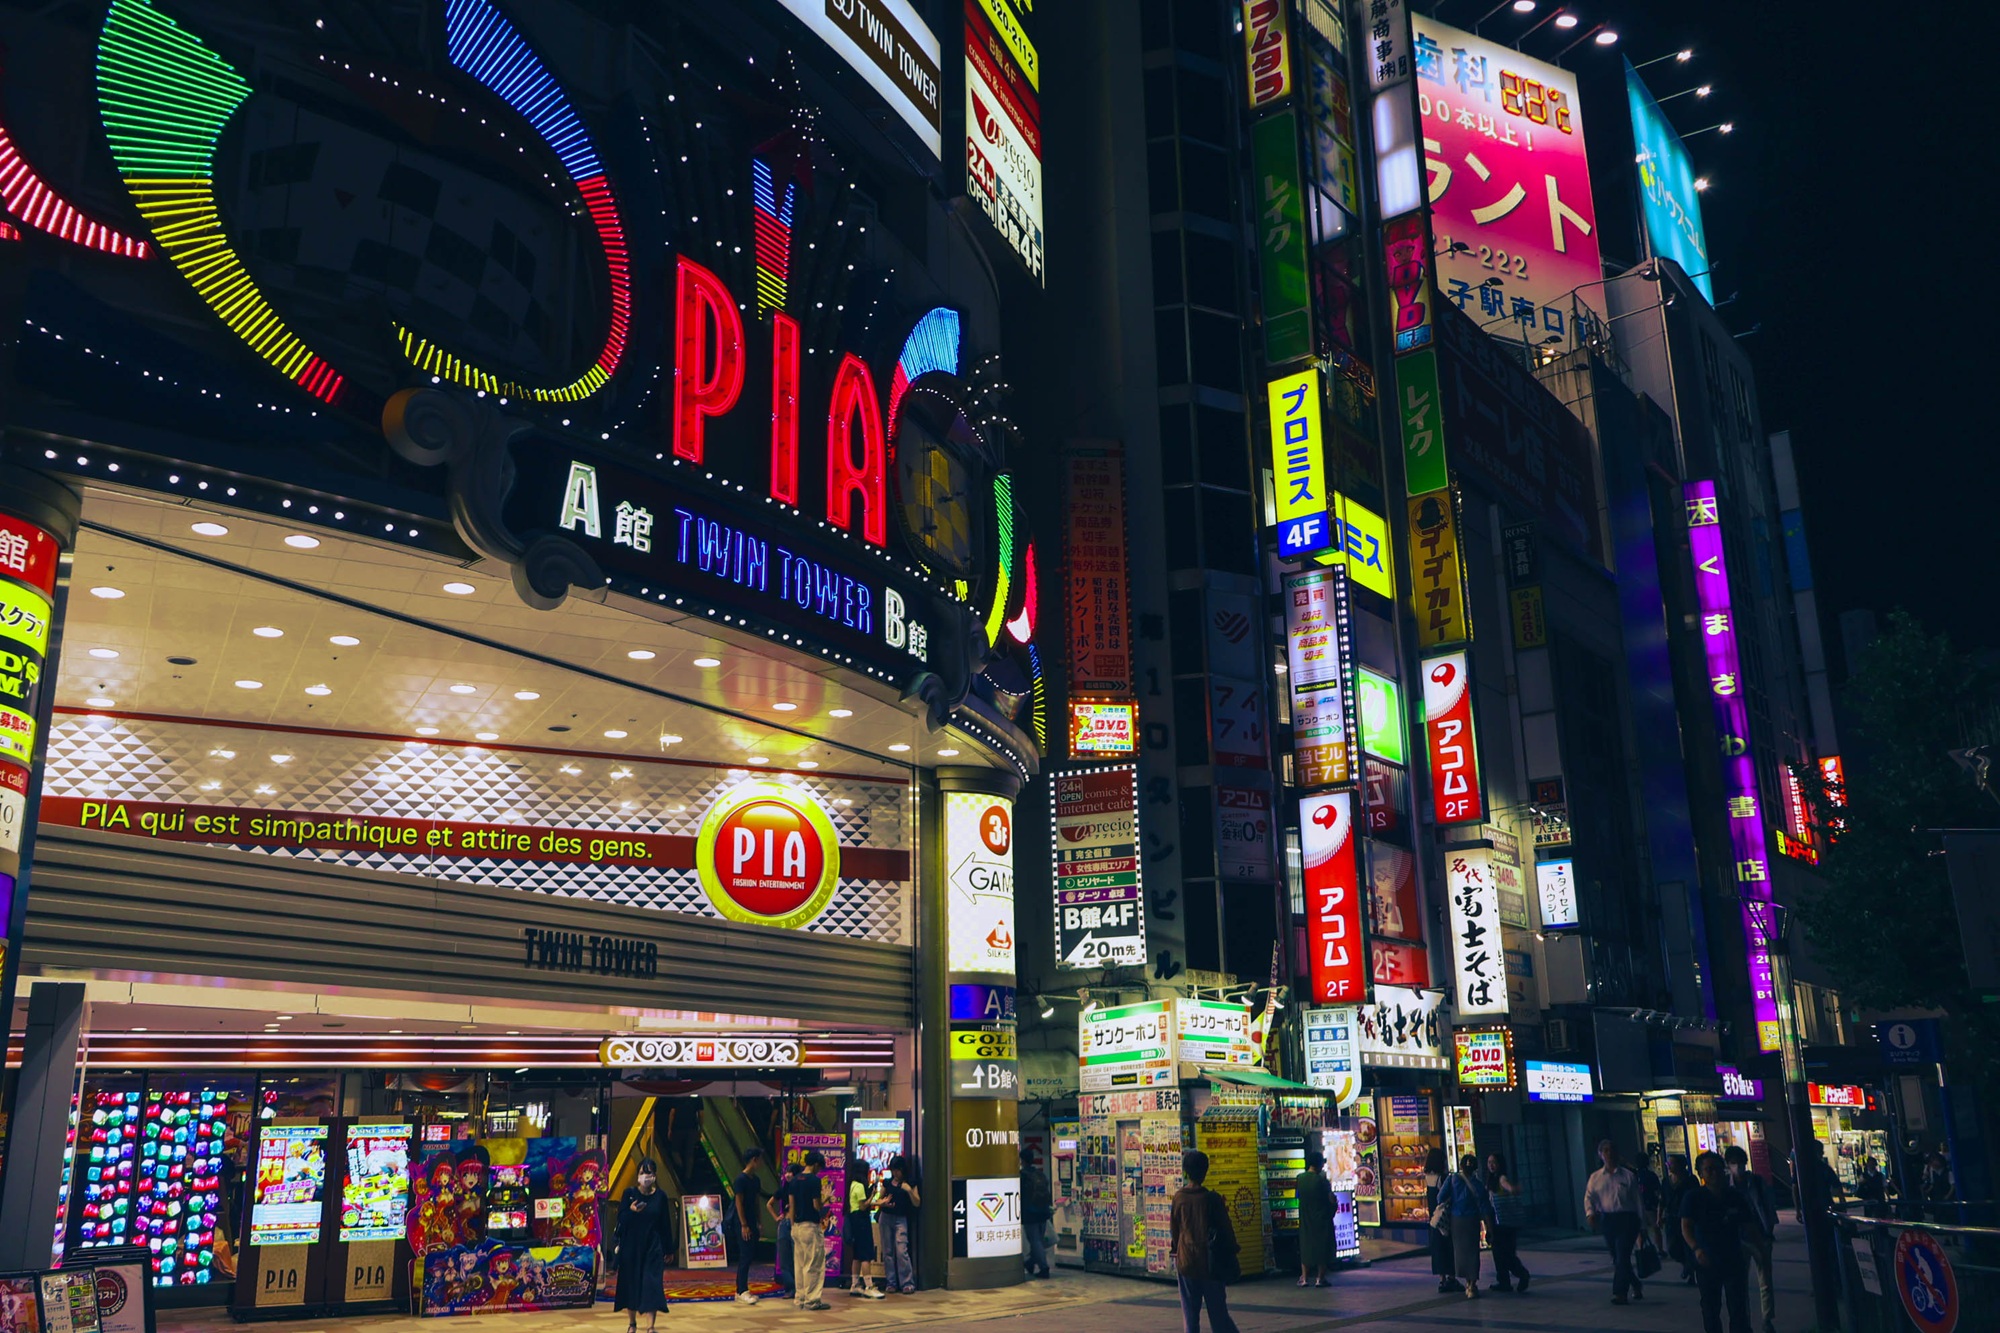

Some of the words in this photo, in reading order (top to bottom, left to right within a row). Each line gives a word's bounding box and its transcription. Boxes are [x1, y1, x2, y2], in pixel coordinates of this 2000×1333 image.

[858, 0, 893, 60] TWIN
[898, 43, 937, 110] TOWER
[968, 142, 995, 197] 24H
[968, 174, 995, 222] OPEN
[1263, 175, 1292, 253] レイク
[1433, 234, 1528, 281] 1-222
[673, 253, 887, 549] PIA
[1407, 385, 1434, 457] レイク
[1281, 383, 1315, 505] プロミス
[1286, 518, 1320, 549] 4F
[674, 505, 769, 594] TWIN
[776, 547, 873, 635] TOWER
[1292, 622, 1332, 637] チケット
[1094, 719, 1127, 730] DVD
[1298, 713, 1340, 726] サンクーポン
[1299, 746, 1343, 765] 当ビル
[1437, 719, 1468, 795] アコム
[1060, 781, 1081, 793] 24H
[1060, 792, 1081, 802] OPEN
[1085, 787, 1118, 799] comics
[1120, 785, 1129, 796] &
[1060, 802, 1104, 814] internet
[1222, 789, 1263, 808] アコム
[1445, 799, 1469, 818] 2F
[80, 802, 130, 830] PIA
[140, 809, 186, 837] qui
[194, 812, 240, 836] est
[249, 813, 418, 849] simpathique
[426, 826, 453, 848] et
[461, 826, 531, 852] attire
[539, 831, 583, 858] des
[589, 838, 653, 862] gens.
[988, 814, 1008, 847] 3F
[1075, 817, 1131, 840] aprecio
[733, 827, 806, 878] PIA
[1239, 864, 1254, 877] 2F
[733, 878, 757, 888] FASHION
[759, 879, 805, 890] ENTERTAINMENT
[1076, 876, 1115, 887] ビリヤード
[1319, 886, 1349, 967] アコム
[525, 928, 584, 974] TWIN
[589, 935, 658, 980] TOWER
[1455, 886, 1497, 1006] 富士そば
[1373, 949, 1395, 980] 2F
[1326, 979, 1350, 997] 2F
[1190, 1015, 1241, 1031] サンクーポン
[1310, 1013, 1345, 1024] 新幹線
[1095, 1023, 1156, 1046] サンクーポン
[1311, 1028, 1346, 1040] 商品券
[1311, 1045, 1348, 1056] チケット
[1472, 1048, 1501, 1062] DVD
[1312, 1060, 1340, 1070] Exchange
[985, 1131, 1007, 1146] TWIN
[265, 1268, 298, 1290] PIA
[354, 1265, 385, 1286] PIA
